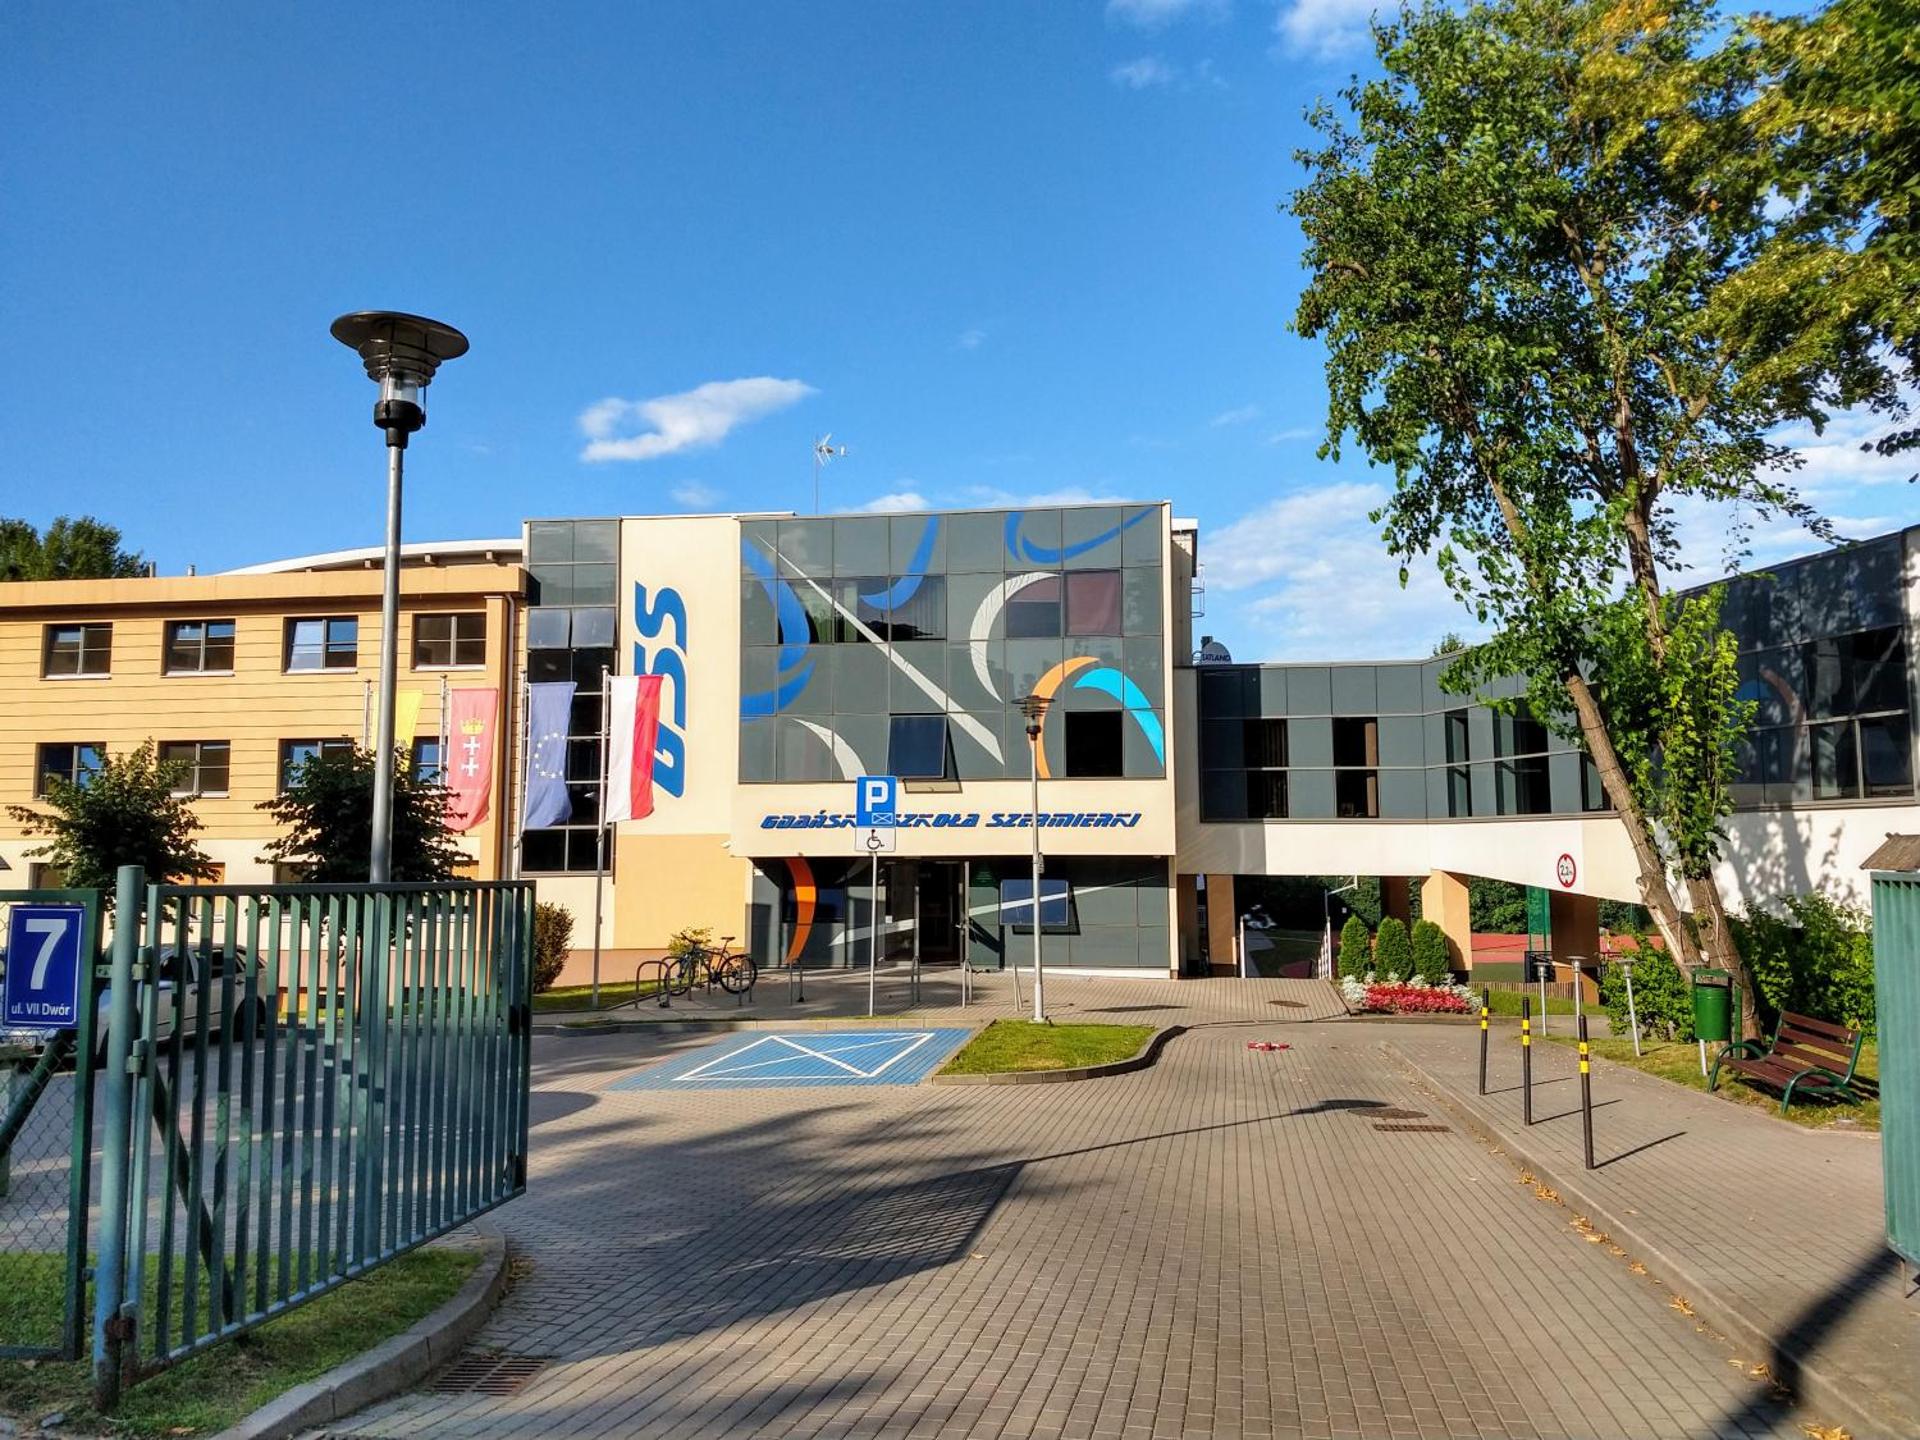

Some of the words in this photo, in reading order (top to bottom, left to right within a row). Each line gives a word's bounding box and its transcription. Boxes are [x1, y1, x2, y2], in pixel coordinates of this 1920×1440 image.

[865, 780, 889, 812] P
[760, 809, 857, 829] GDAŃSK
[985, 813, 1142, 828] SZERMIERKI
[26, 919, 67, 990] 7
[11, 1003, 23, 1014] ul.
[26, 1003, 39, 1015] VII
[42, 1003, 71, 1016] Dwór
